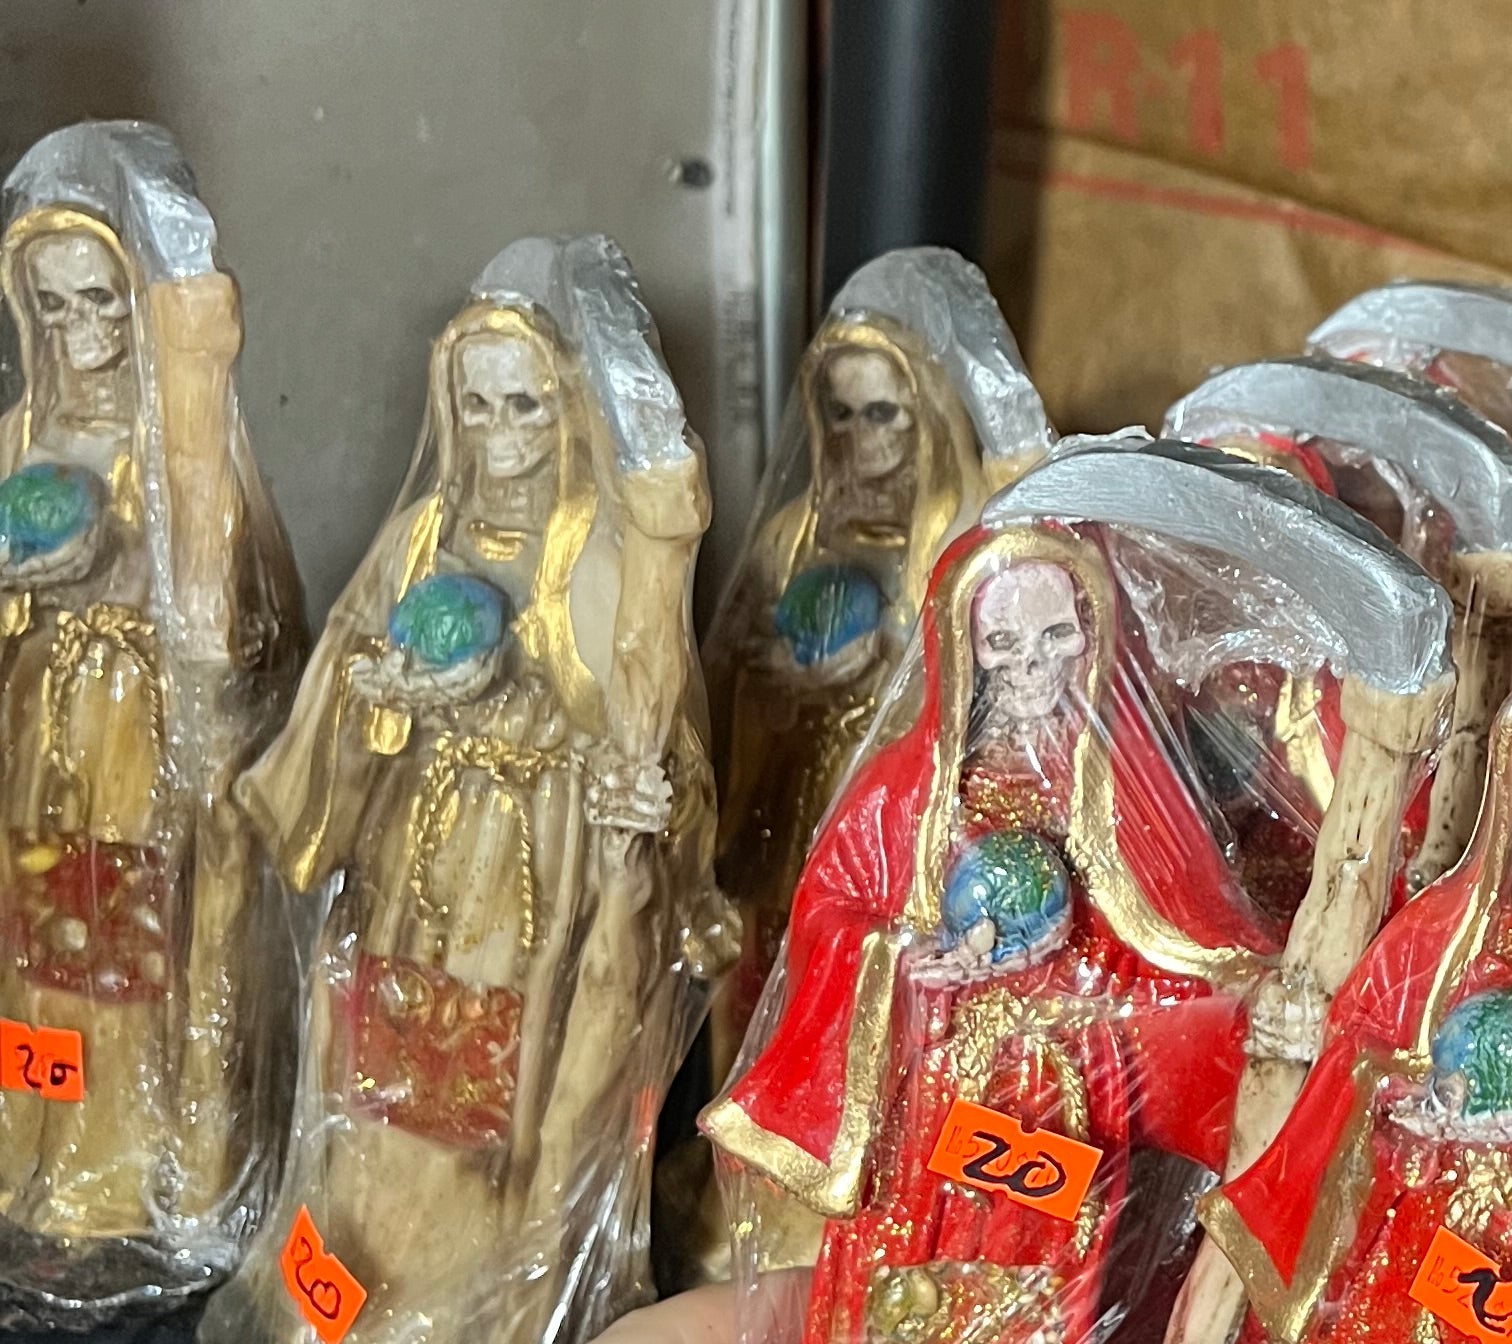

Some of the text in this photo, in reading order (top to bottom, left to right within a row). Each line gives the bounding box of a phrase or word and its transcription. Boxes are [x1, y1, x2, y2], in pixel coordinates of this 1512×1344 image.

[16, 1043, 79, 1088] 20
[963, 1131, 1067, 1198] 20
[291, 1236, 342, 1320] 20
